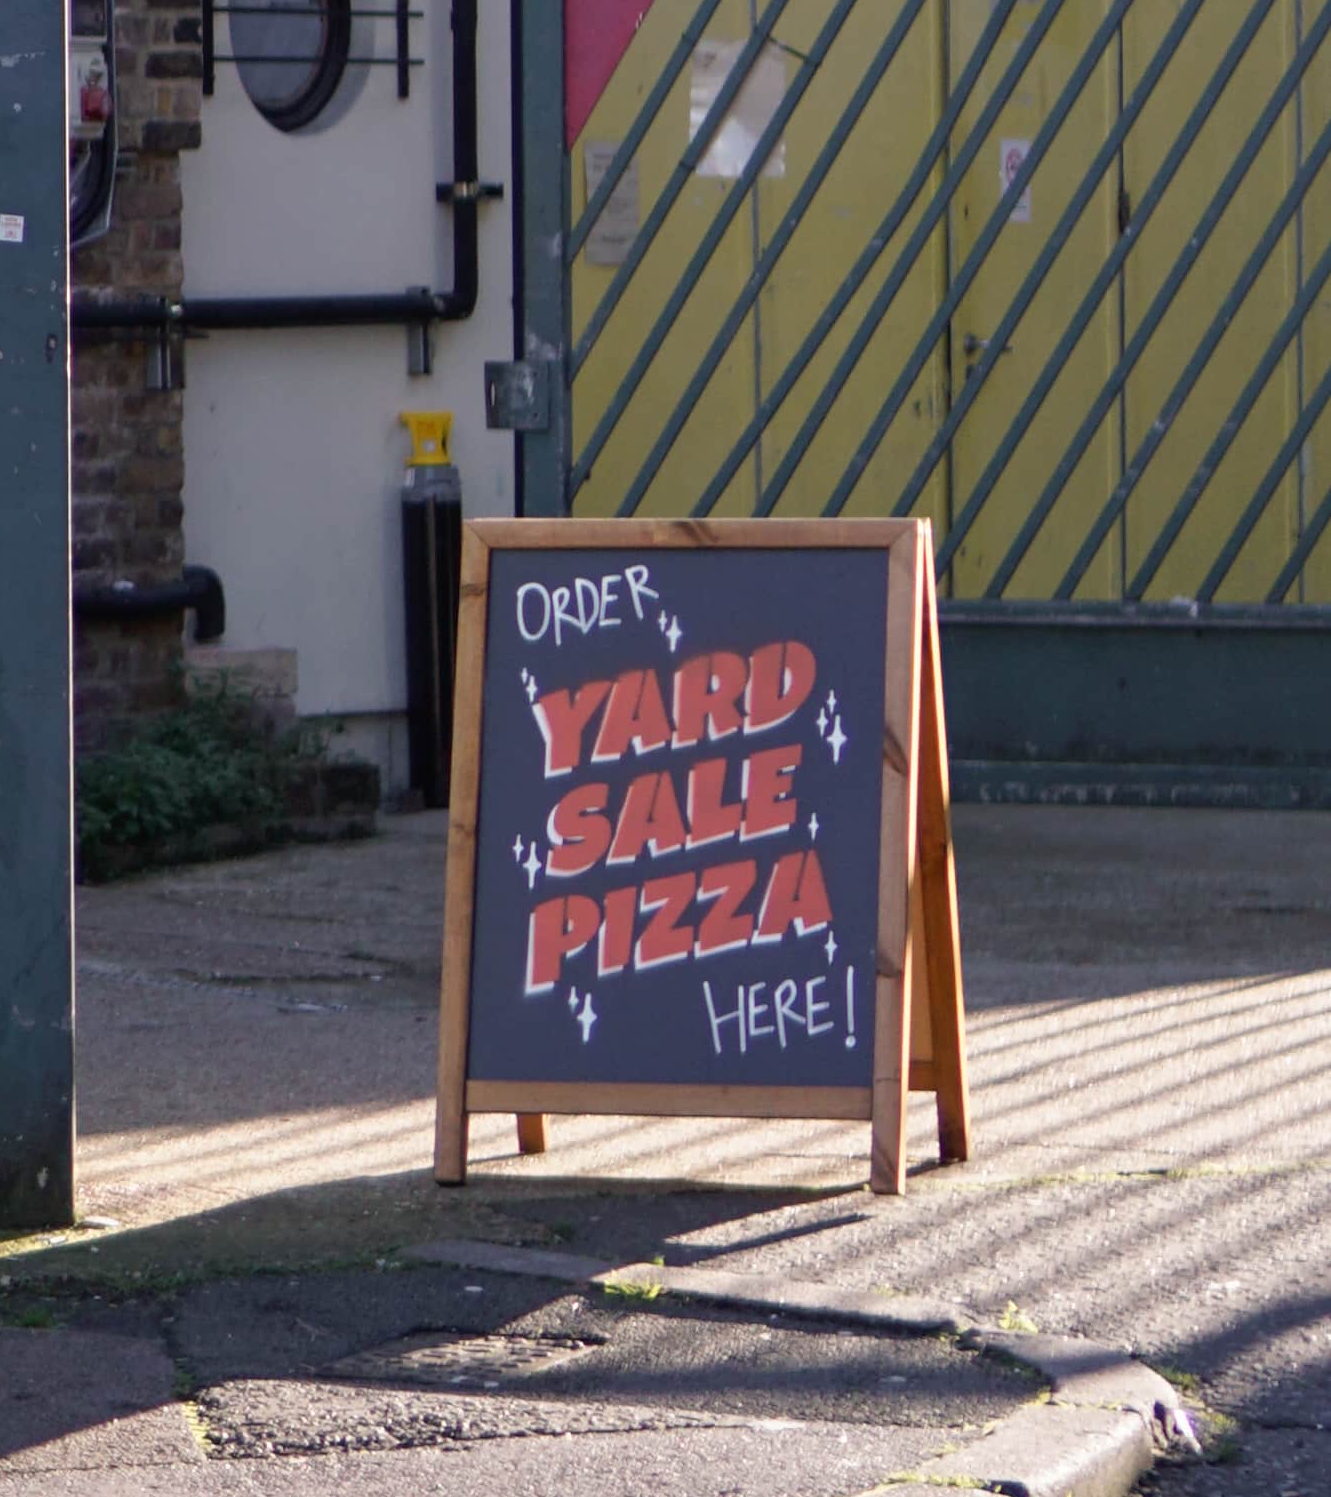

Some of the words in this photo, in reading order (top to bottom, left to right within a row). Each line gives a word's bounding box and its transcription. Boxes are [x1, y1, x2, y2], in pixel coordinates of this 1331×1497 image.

[515, 564, 660, 647] ORDER
[532, 640, 817, 778] YARD
[544, 743, 804, 878] SALE
[524, 849, 833, 996] PIZZA
